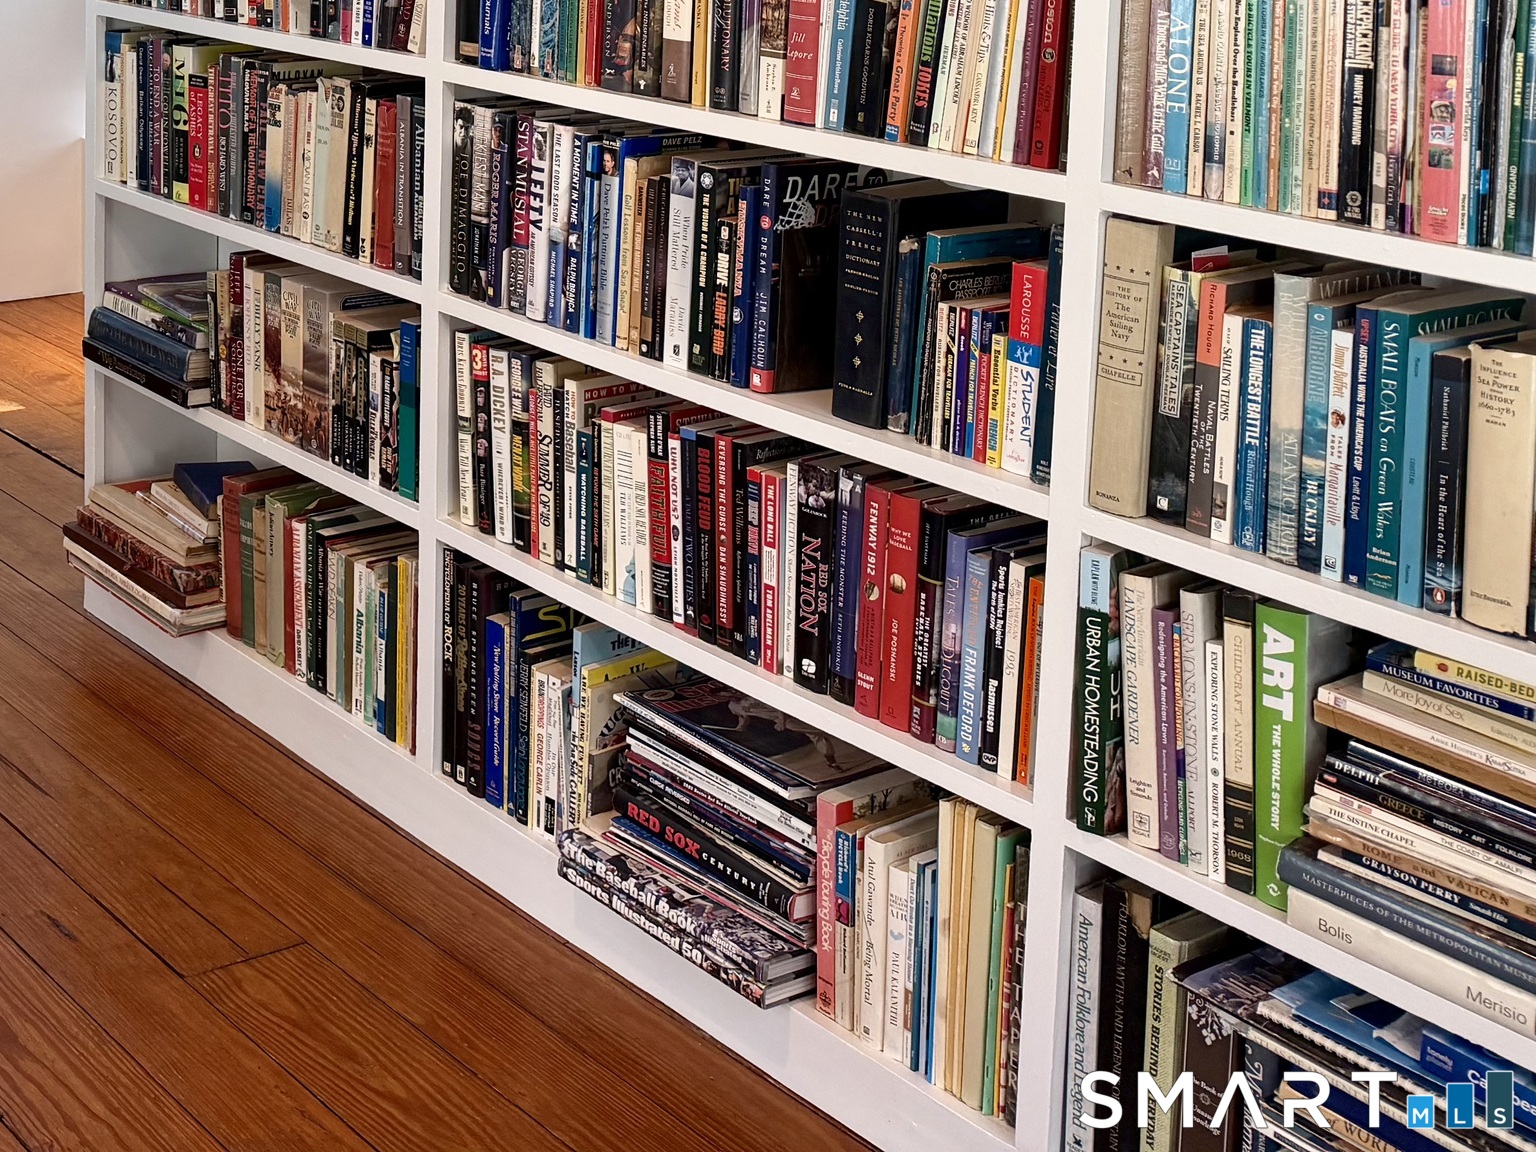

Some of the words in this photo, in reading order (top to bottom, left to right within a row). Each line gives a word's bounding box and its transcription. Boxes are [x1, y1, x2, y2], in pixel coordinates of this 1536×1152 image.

[1167, 14, 1190, 114] ALONE
[106, 86, 118, 162] KOSOVO
[516, 120, 530, 170] STAN
[512, 172, 528, 240] MUSIAL
[759, 292, 768, 314] JIM
[1019, 274, 1034, 339] LAROUSSE
[1106, 310, 1140, 323] American
[1115, 302, 1130, 312] The
[756, 318, 766, 368] CALHOUN
[1109, 320, 1133, 333] Sailing
[1111, 330, 1130, 342] Navy
[1251, 329, 1265, 349] THE
[1383, 320, 1400, 367] SMALL
[491, 354, 505, 380] R.A.
[1101, 367, 1137, 381] CHAPELLE
[1223, 346, 1232, 385] SAILING
[1249, 349, 1264, 394] LONGEST
[490, 385, 506, 434] DICKEY
[1018, 370, 1035, 448] STUDENT
[1219, 387, 1230, 422] TERMS
[1246, 395, 1262, 446] BATTLE
[1381, 371, 1398, 434] BOATS
[1381, 438, 1388, 452] on
[697, 448, 711, 494] BLOOD
[1378, 455, 1396, 499] Green
[650, 465, 668, 562] FAITHFUL
[697, 496, 711, 530] FEUD
[1095, 491, 1120, 503] BONANZA
[868, 501, 879, 551] FENWAY
[1375, 501, 1393, 539] Waters
[799, 532, 822, 636] NATION
[866, 552, 876, 576] 1912
[1086, 618, 1101, 670] URBAN
[1123, 586, 1137, 670] LANDSCAPE
[966, 647, 978, 691] FRANK
[1210, 650, 1218, 695] EXPLORING
[1233, 635, 1243, 709] CHILDCRAFT
[1263, 623, 1295, 722] ART
[1382, 664, 1434, 687] MUSEUM
[1436, 681, 1499, 709] FAVORITES
[1456, 666, 1535, 699] RAISED-BED
[960, 693, 976, 742] DEFORD
[985, 678, 998, 733] Rasmussen
[1126, 674, 1140, 746] GARDENER
[1211, 696, 1219, 727] STONE
[1083, 673, 1101, 803] HOMESTEADING
[1211, 729, 1219, 762] WALLS
[1233, 716, 1243, 773] ANNUAL
[1272, 724, 1281, 749] THE
[1270, 750, 1281, 792] WHOLE
[1335, 761, 1380, 785] DELPHI
[1270, 793, 1281, 831] STORY
[1328, 808, 1346, 820] THE
[1345, 812, 1380, 834] SISTINE
[1380, 827, 1416, 848] CHAPEL
[1379, 794, 1425, 819] GREECE
[627, 801, 662, 835] RED
[664, 825, 702, 860] SOX
[702, 852, 757, 891] CENTURY
[1226, 848, 1252, 863] 1968
[595, 859, 657, 910] Baseball
[657, 897, 698, 935] Book
[1362, 856, 1417, 886] GRAYSON
[1420, 881, 1461, 903] PERRY
[1302, 873, 1375, 910] MASTERPIECES
[1376, 907, 1391, 918] OF
[1393, 911, 1414, 929] THE
[1416, 923, 1503, 967] METROPOLITAN
[1318, 918, 1353, 945] Bolis
[1077, 913, 1093, 985] American
[1075, 984, 1092, 1044] Folklore
[1152, 965, 1163, 1023] STORIES
[1466, 985, 1528, 1025] Merisio
[1150, 1025, 1160, 1076] BEHIND
